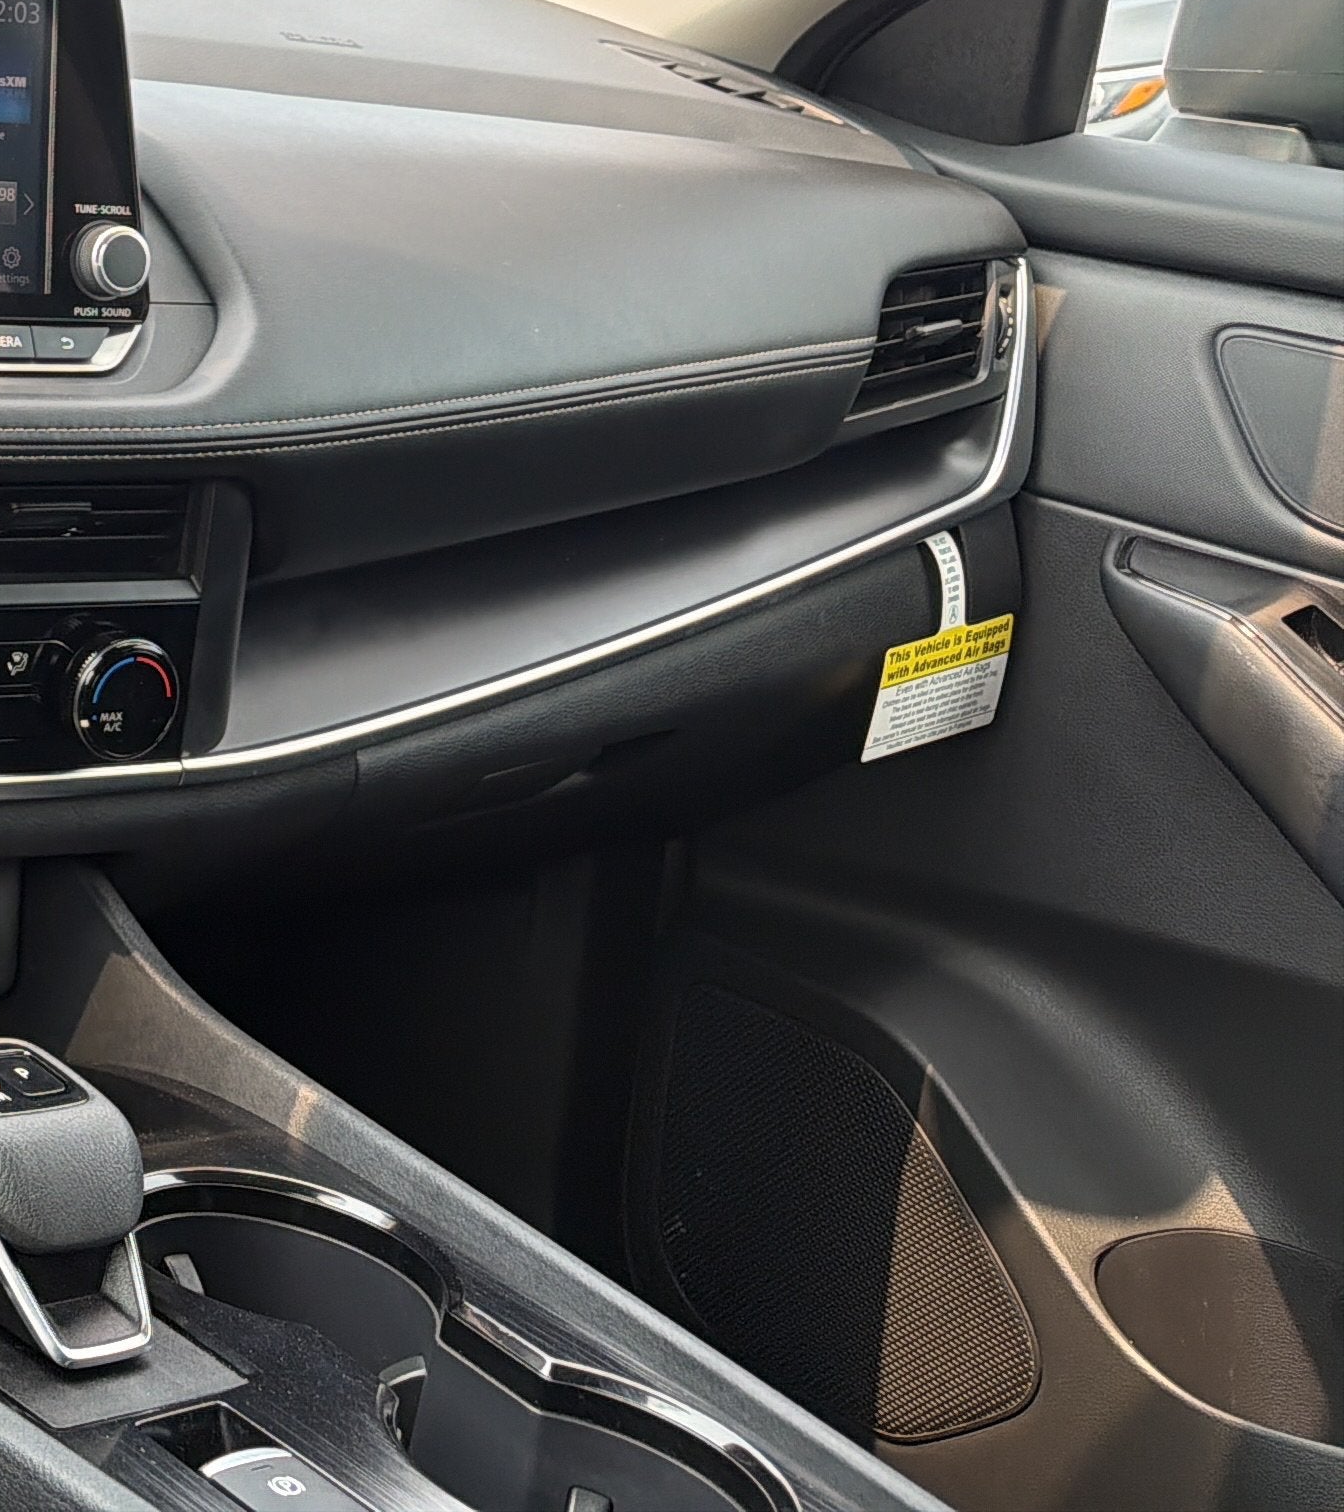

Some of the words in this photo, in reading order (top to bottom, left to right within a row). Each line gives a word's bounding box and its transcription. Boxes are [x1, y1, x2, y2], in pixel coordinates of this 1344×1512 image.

[0, 187, 16, 202] 98
[74, 203, 131, 216] TUNE-SCROLL
[73, 306, 98, 317] PUSH
[101, 307, 131, 318] SOUND
[888, 650, 911, 665] This
[914, 639, 950, 658] Vehicle
[953, 634, 962, 646] is
[965, 618, 1011, 643] Equipped
[887, 666, 909, 682] with
[912, 652, 962, 674] Advanced
[964, 644, 981, 659] Air
[982, 638, 1005, 656] Bags
[99, 711, 123, 722] MAX
[103, 722, 123, 733] A/C
[13, 1067, 30, 1080] P
